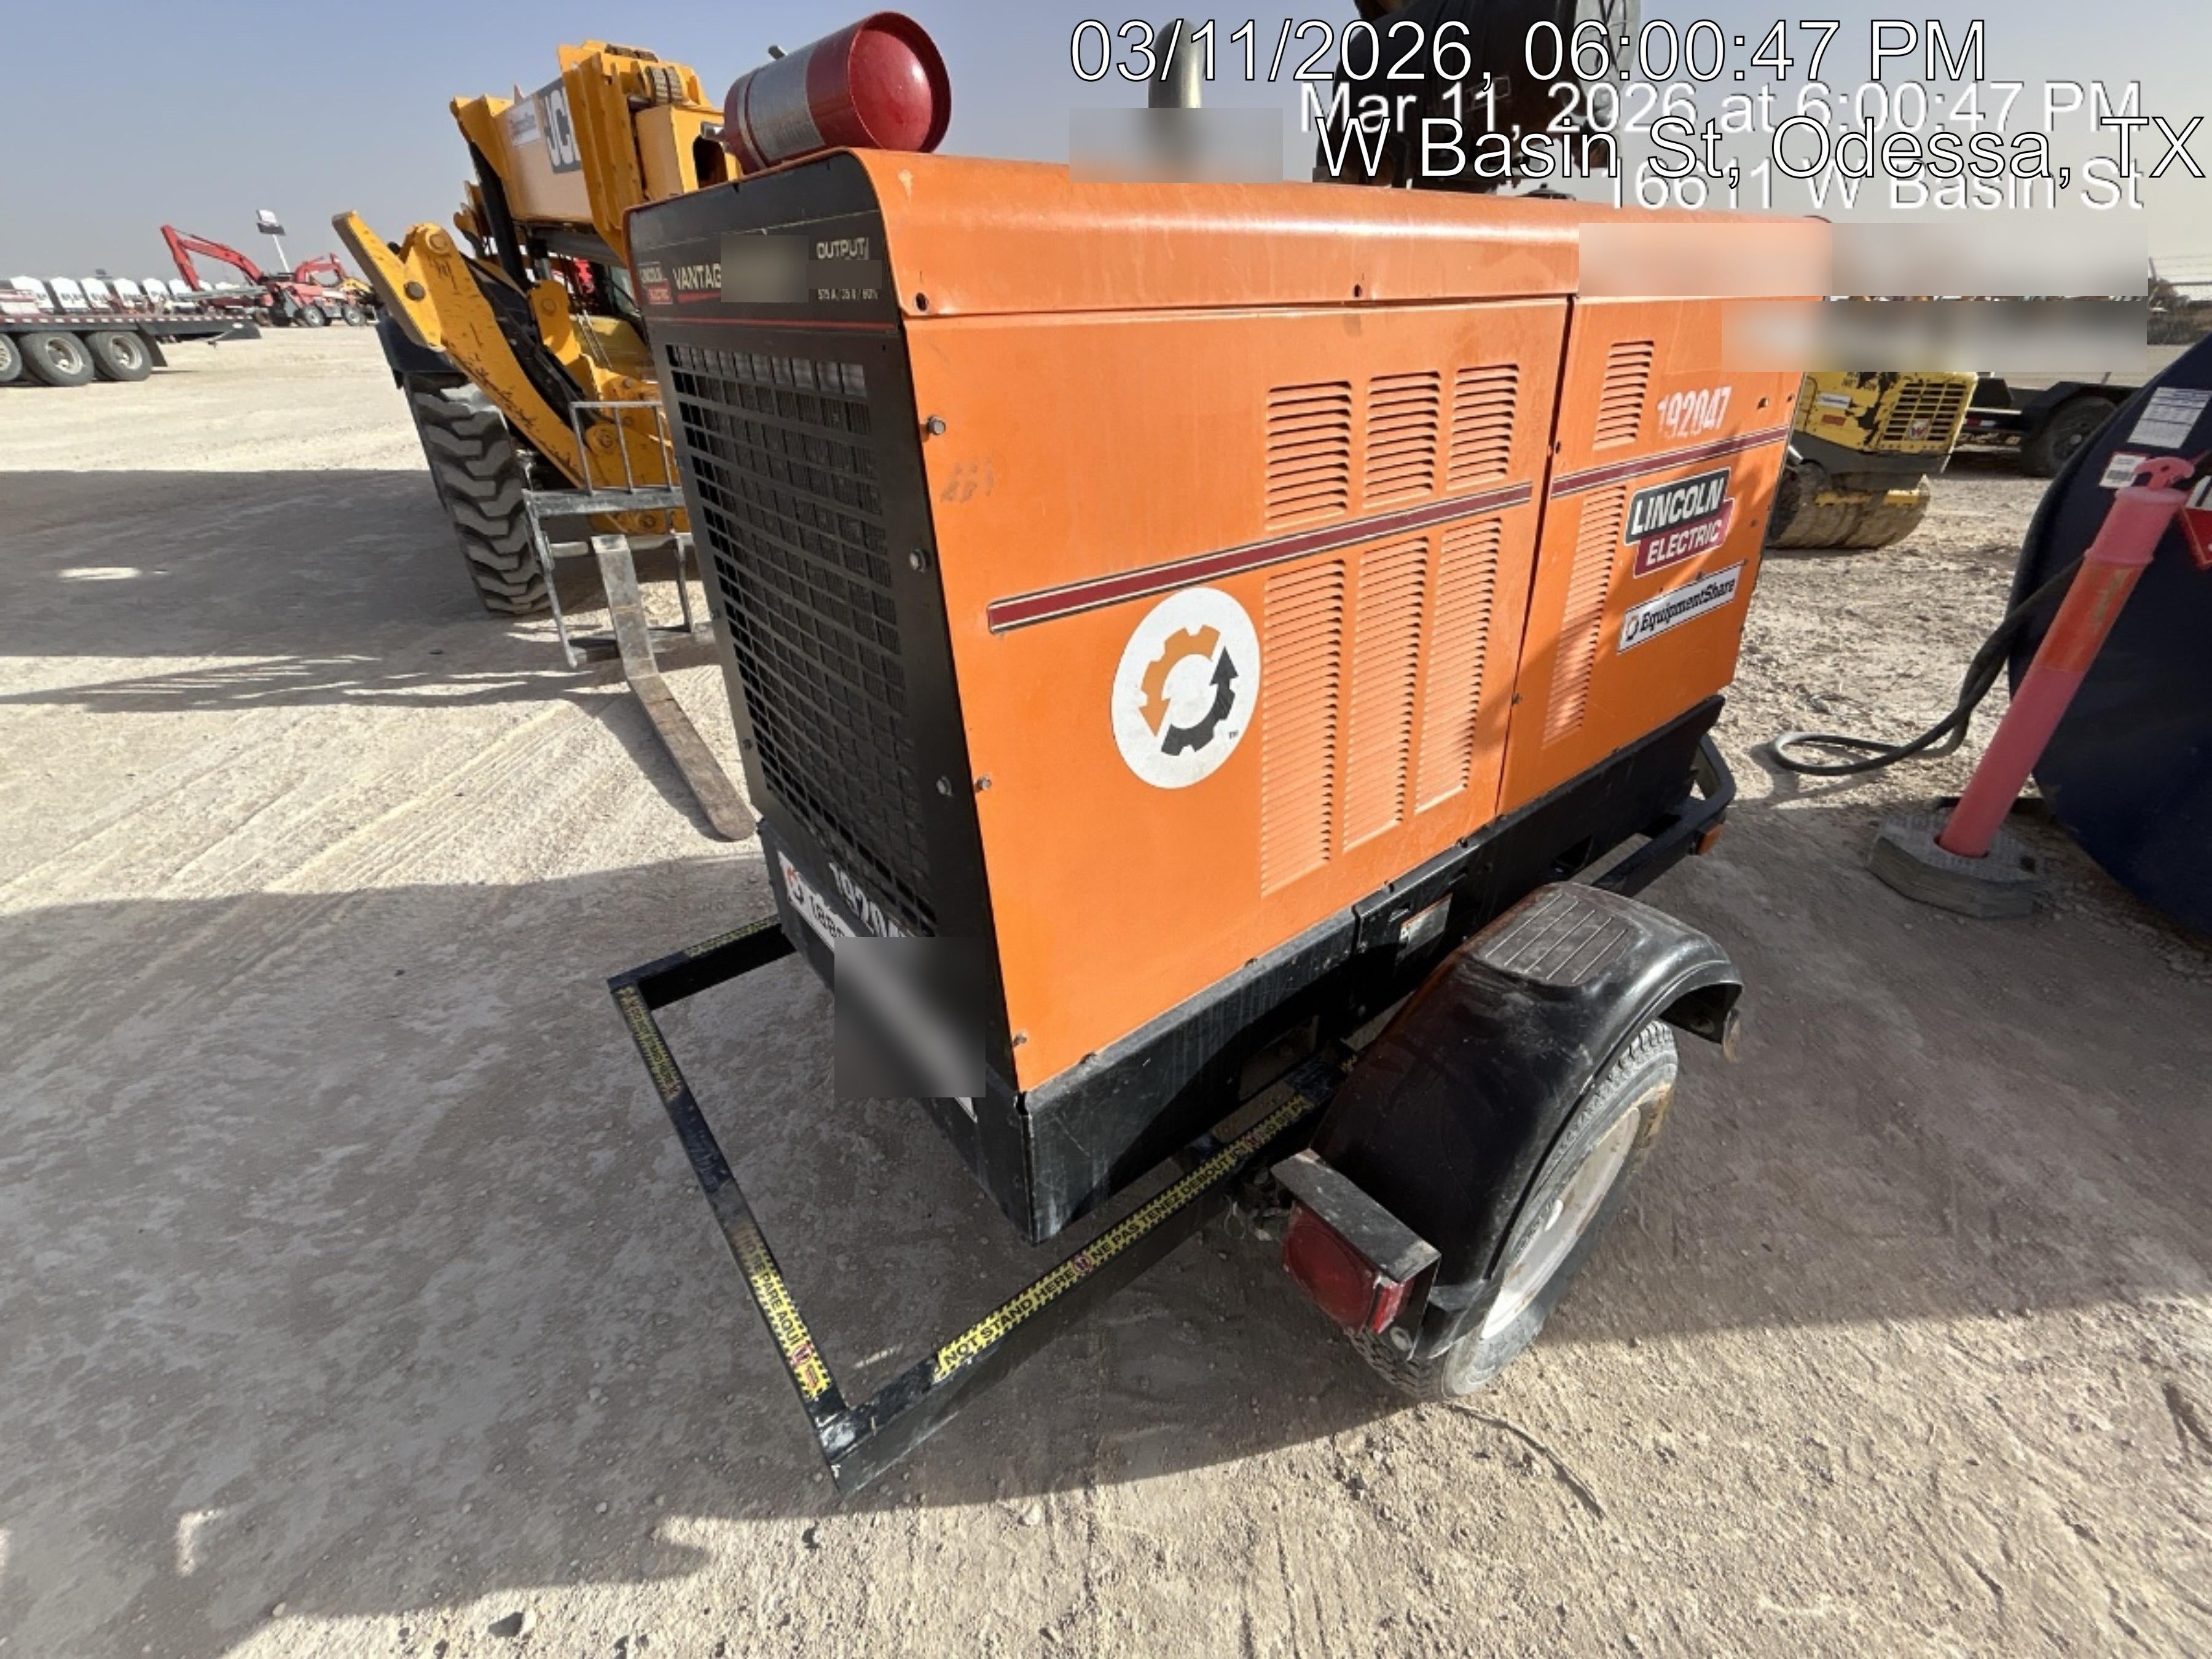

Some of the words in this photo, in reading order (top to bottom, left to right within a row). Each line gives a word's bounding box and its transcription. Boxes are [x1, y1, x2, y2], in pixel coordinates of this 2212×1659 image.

[816, 237, 865, 259] OUTPUT
[672, 263, 721, 290] VANTAG
[1631, 477, 1724, 536] LINCOLN
[1645, 519, 1723, 568] ELECTRIC
[1638, 577, 1736, 633] EquipmentShare
[760, 1273, 783, 1310] PARE
[944, 1334, 979, 1365] NOT
[981, 1298, 1033, 1339] STAND
[1035, 1269, 1075, 1300] HERE
